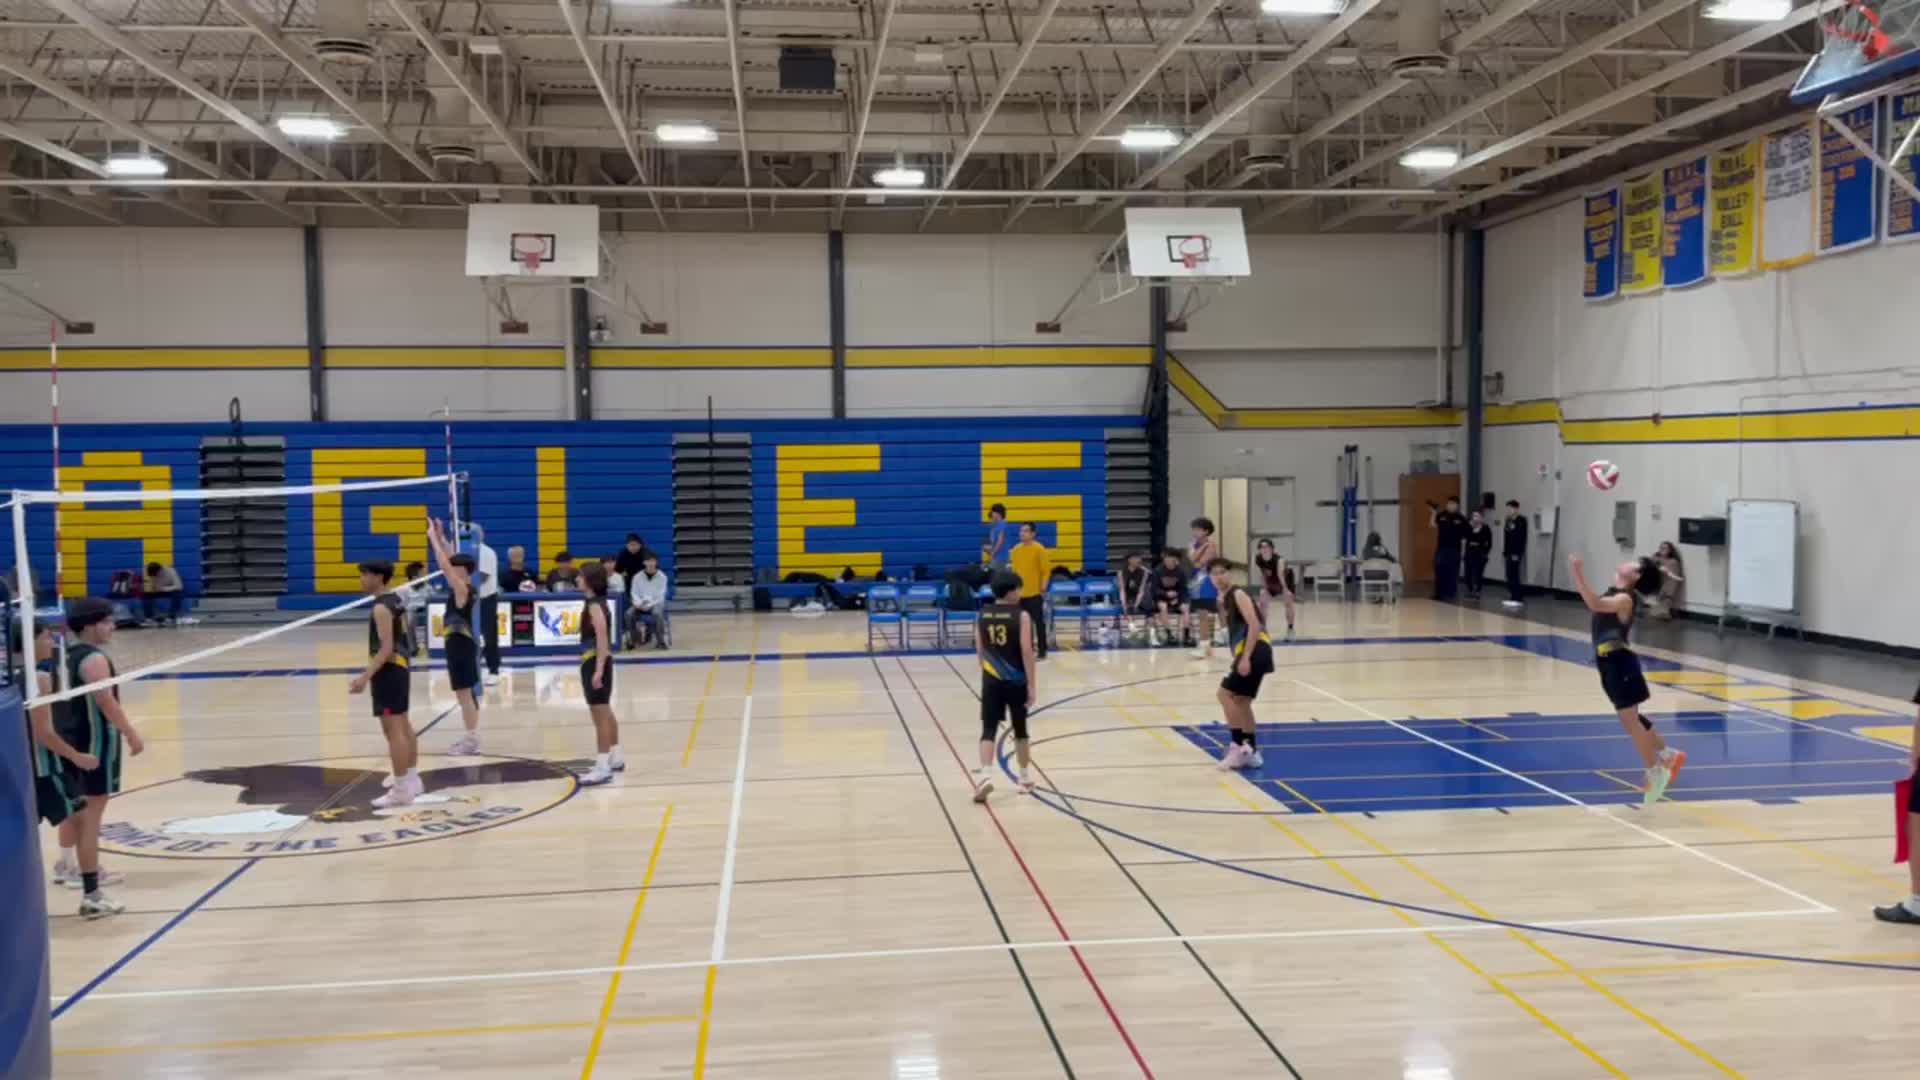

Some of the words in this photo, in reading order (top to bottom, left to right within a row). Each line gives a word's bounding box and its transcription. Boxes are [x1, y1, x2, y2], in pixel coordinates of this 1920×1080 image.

[987, 624, 1008, 646] 13
[164, 839, 229, 852] OF
[243, 836, 338, 852] THE
[361, 805, 522, 843] EAGLES
